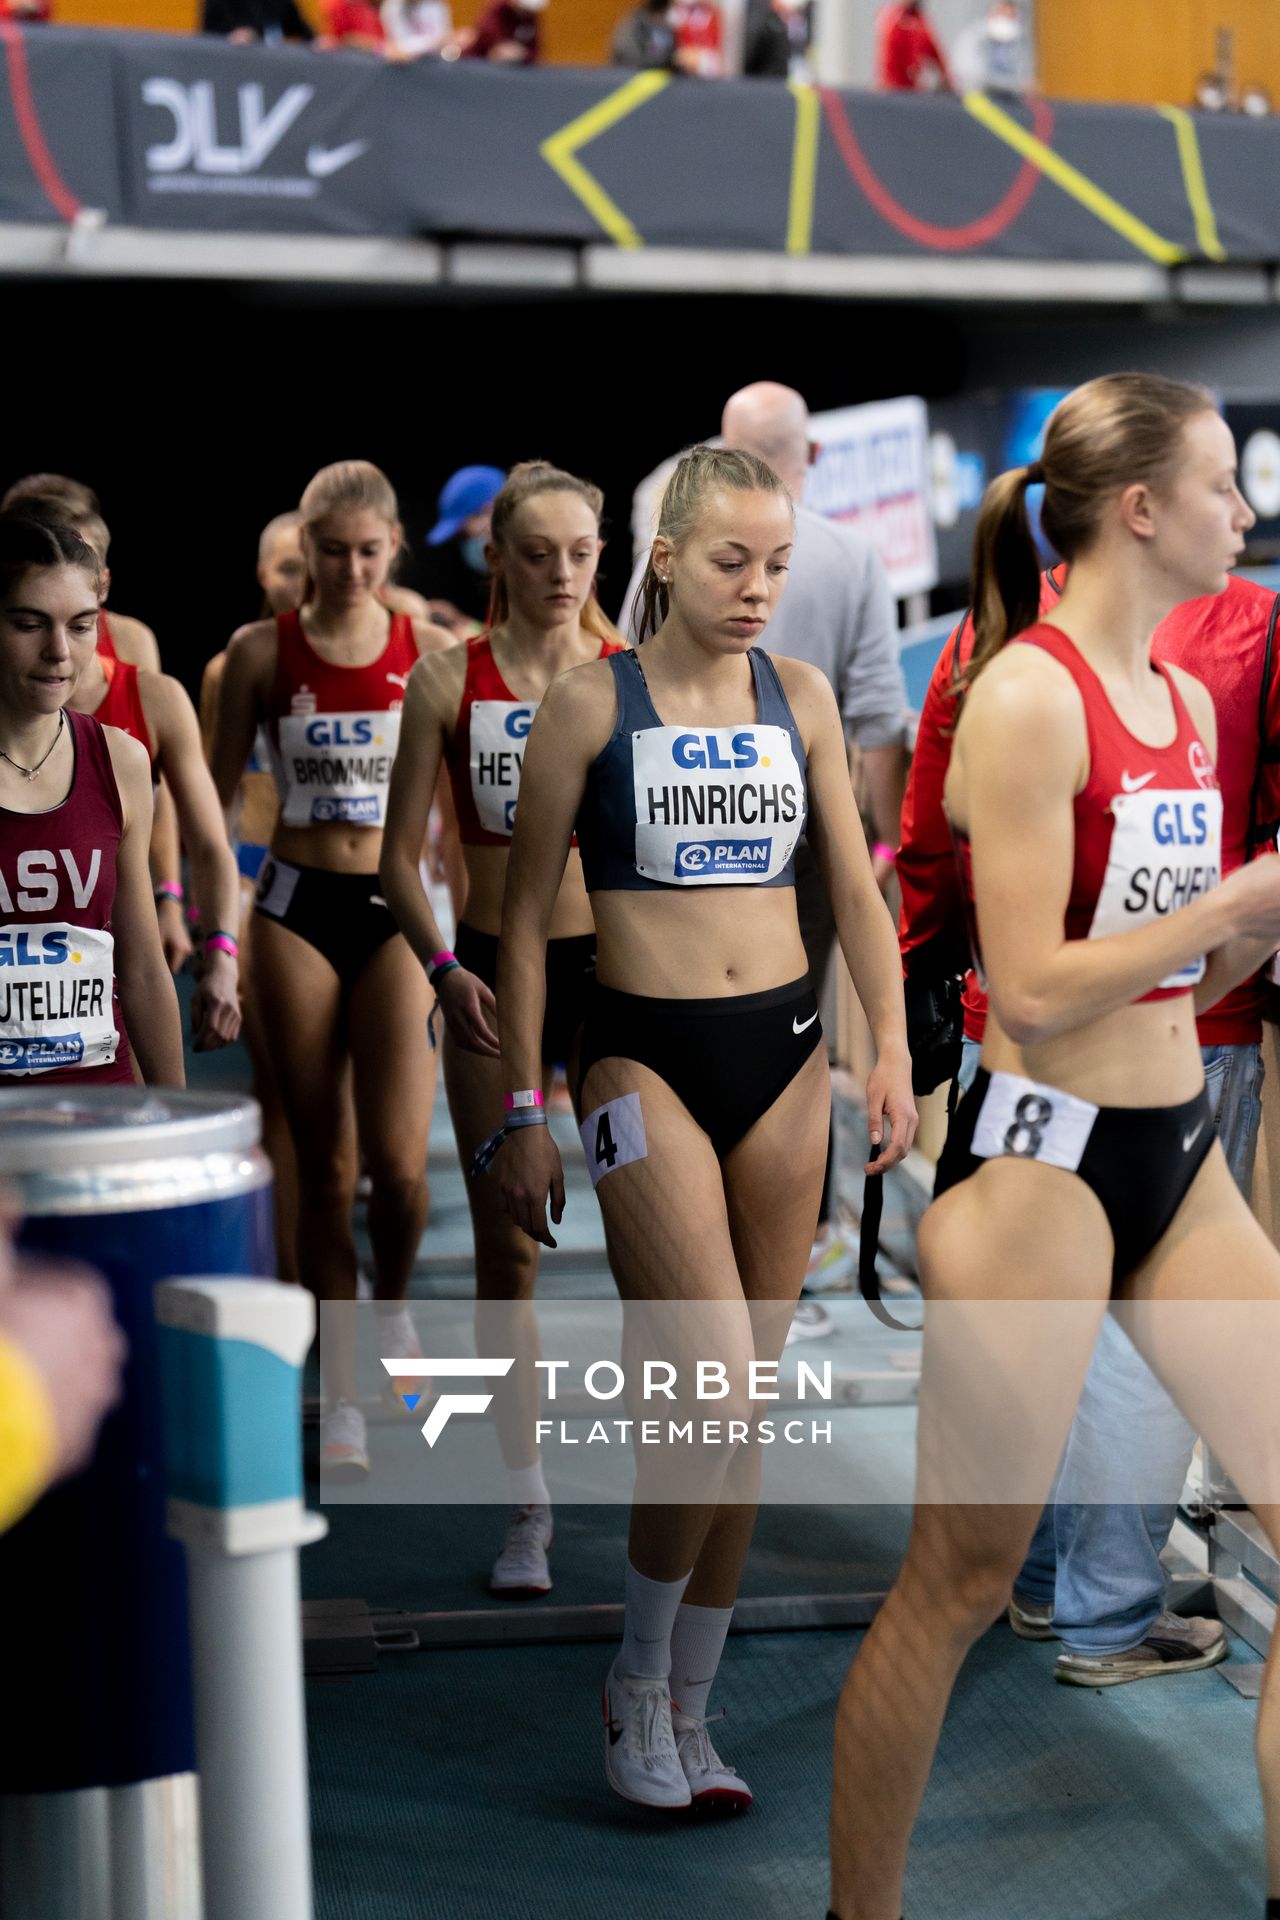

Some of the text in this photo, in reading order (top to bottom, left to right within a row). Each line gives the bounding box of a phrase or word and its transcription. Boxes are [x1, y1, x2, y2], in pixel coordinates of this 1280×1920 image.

[647, 783, 797, 825] HINRICHS
[714, 845, 768, 861] PLAN
[1124, 867, 1217, 914] SCHE
[0, 978, 104, 1023] UTELLIER
[27, 1040, 80, 1056] PLAN
[595, 1111, 617, 1167] 4
[1004, 1093, 1053, 1158] 8
